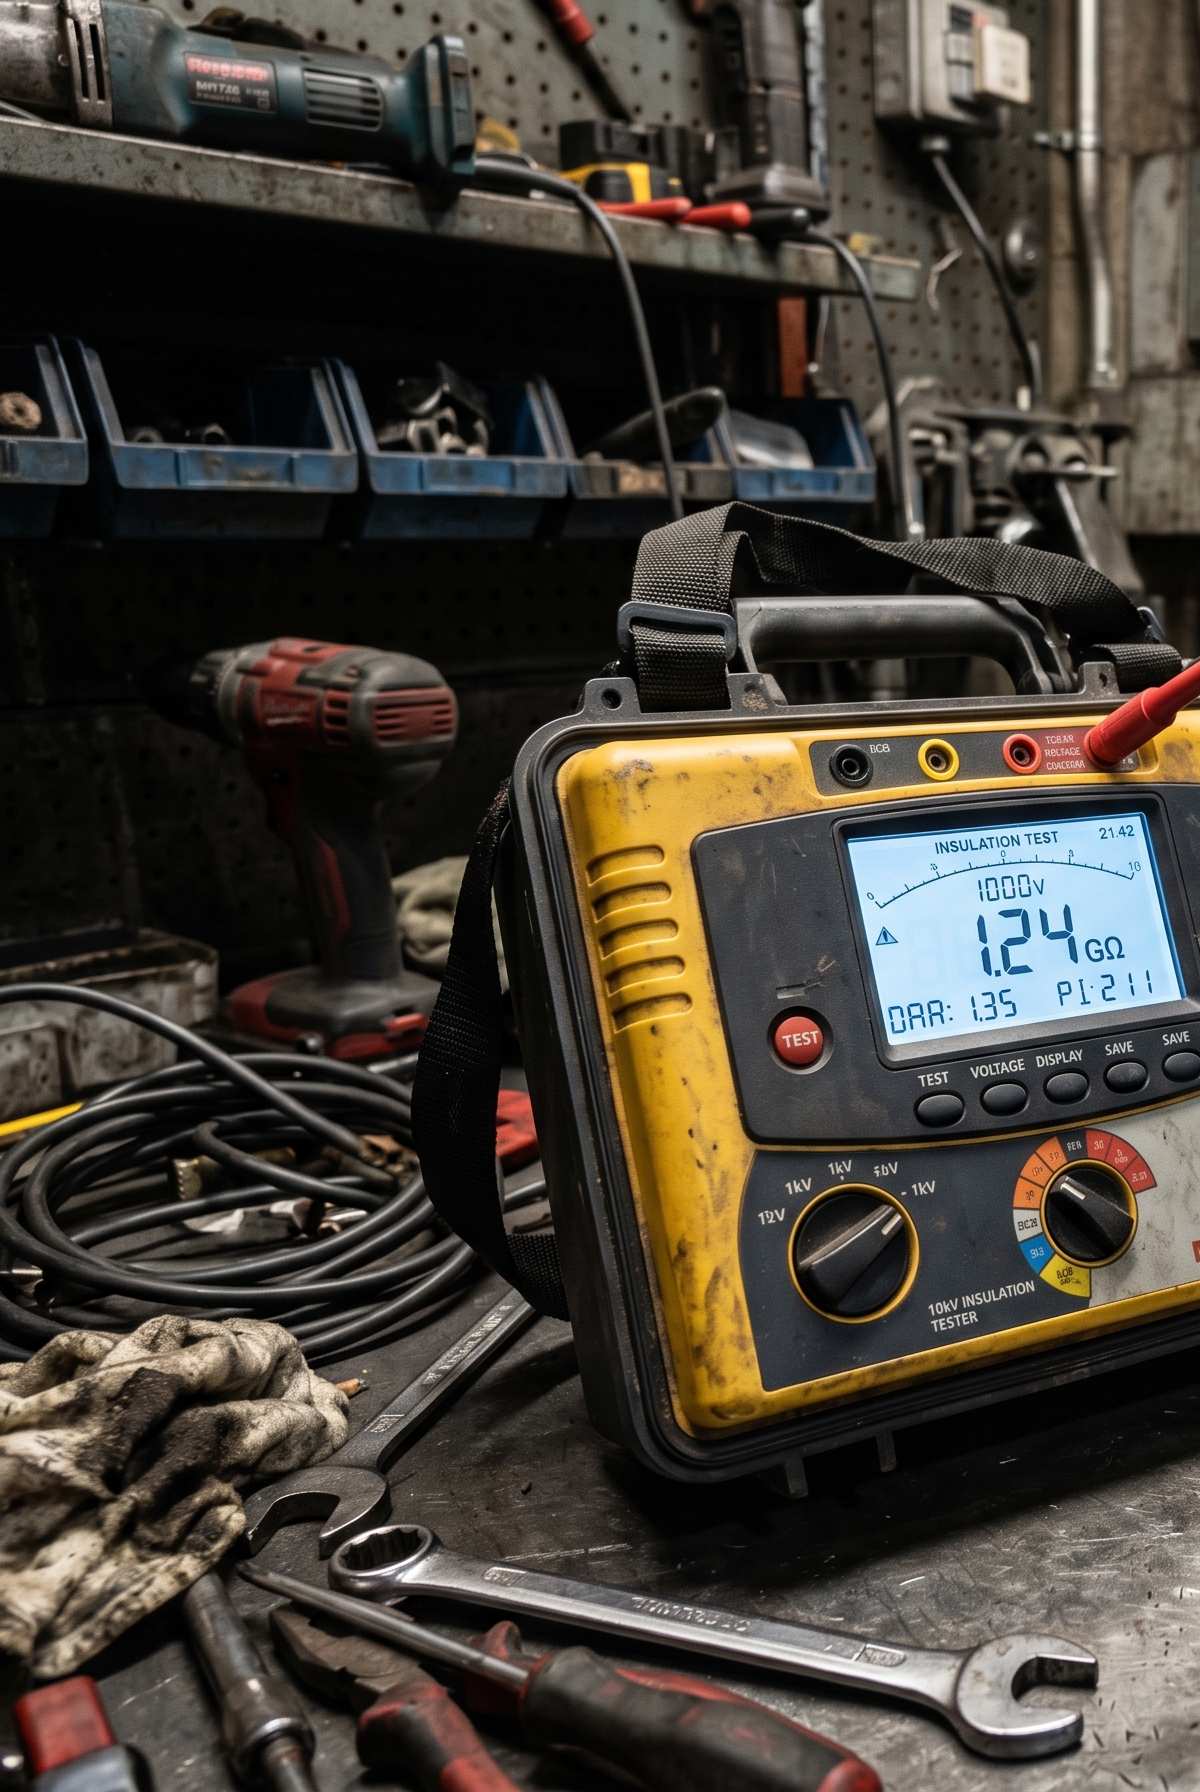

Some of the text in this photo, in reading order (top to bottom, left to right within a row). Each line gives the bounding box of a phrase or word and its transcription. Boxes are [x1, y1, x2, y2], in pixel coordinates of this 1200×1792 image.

[935, 831, 1059, 855] INSULATION TEST
[1099, 825, 1135, 840] 21:42
[977, 904, 1079, 977] 1.24
[970, 988, 1018, 1022] 1.35
[782, 1030, 819, 1048] TEST
[918, 1030, 1190, 1087] TEST VOLTAGE DISPLAY SAVE SAVE
[828, 1160, 852, 1175] 1kV
[785, 1178, 812, 1195] 1kV
[912, 1180, 935, 1196] 1kV
[928, 1280, 1036, 1316] 10kV INSULATION
[931, 1311, 979, 1332] TESTER
